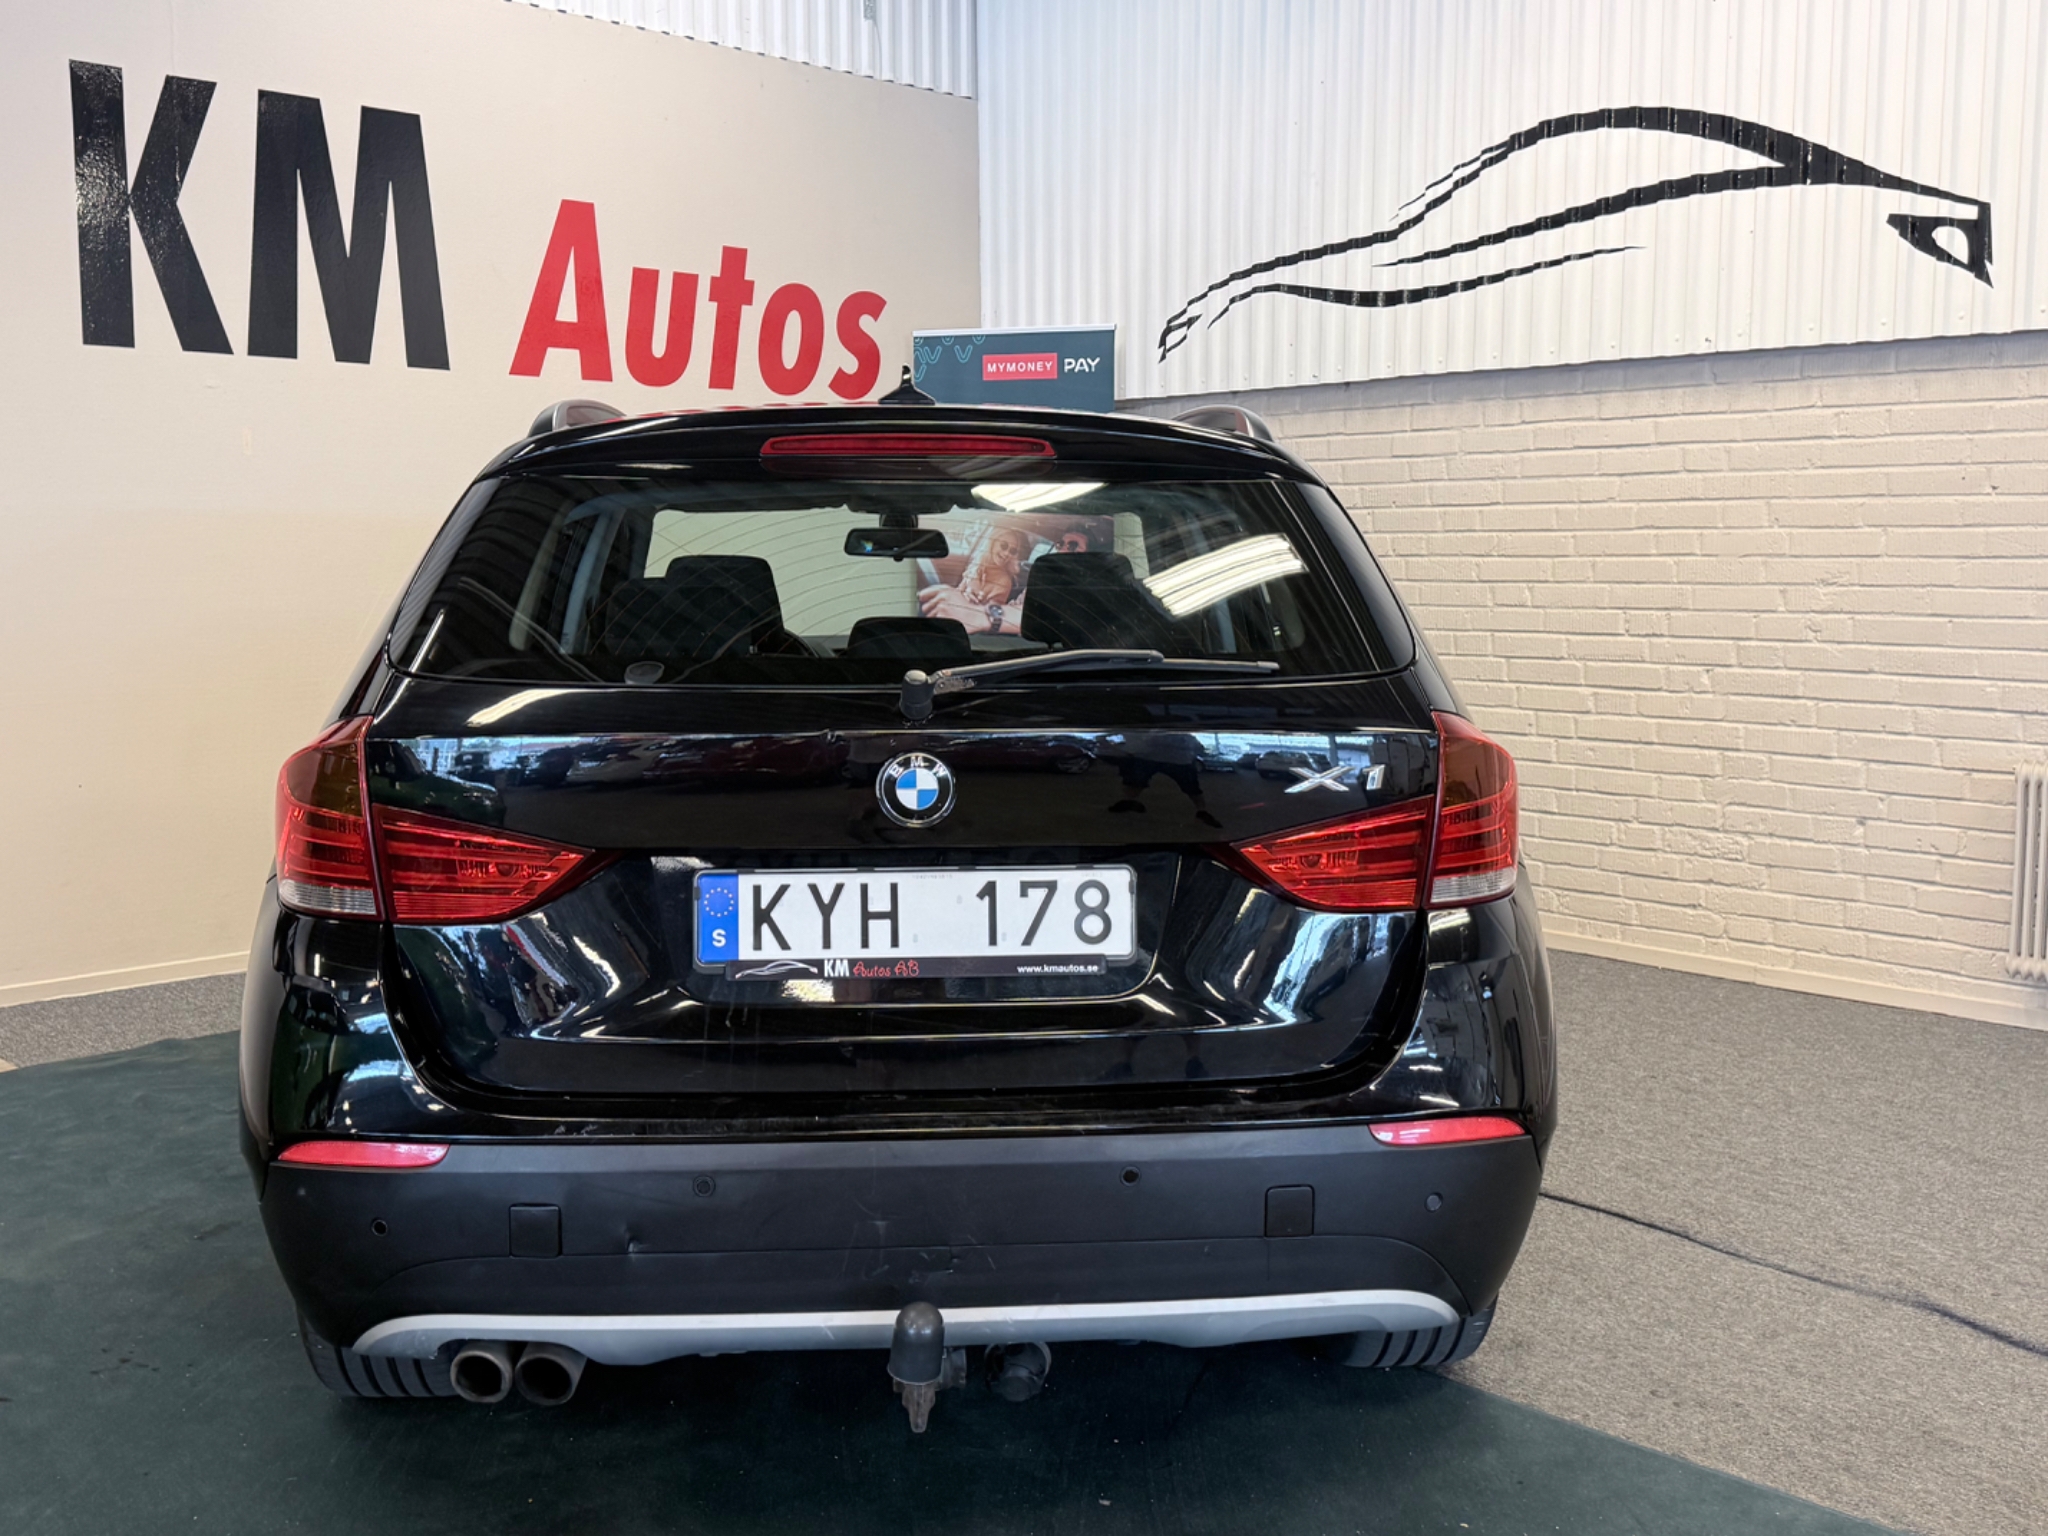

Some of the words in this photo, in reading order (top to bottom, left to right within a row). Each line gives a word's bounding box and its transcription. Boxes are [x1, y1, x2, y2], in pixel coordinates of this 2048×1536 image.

[69, 59, 450, 371] KM
[508, 199, 887, 400] Autos
[987, 361, 1053, 373] MYMONEY
[1063, 357, 1100, 373] PAY
[888, 756, 948, 778] BMW
[1284, 764, 1385, 793] X1
[752, 882, 899, 951] KYH
[975, 879, 1112, 946] 178
[712, 928, 726, 947] S
[824, 959, 849, 977] KM
[853, 961, 891, 977] Autos
[895, 959, 919, 976] AB
[1016, 963, 1098, 973] www.kmautos.se
